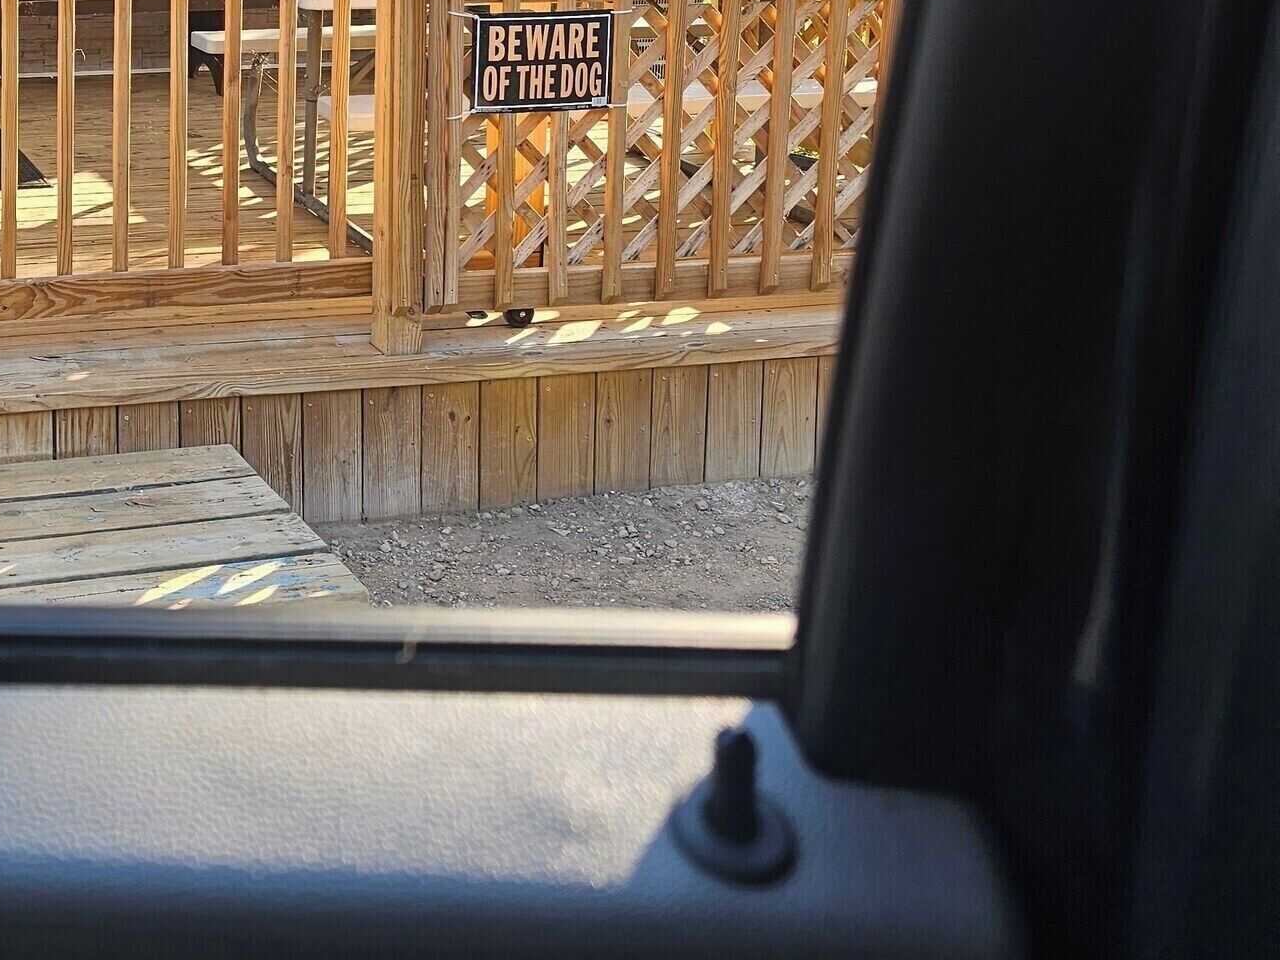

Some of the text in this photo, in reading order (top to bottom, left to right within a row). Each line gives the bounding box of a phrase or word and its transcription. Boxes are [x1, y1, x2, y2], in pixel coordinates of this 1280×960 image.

[488, 22, 600, 62] BEWARE
[482, 61, 603, 102] OF THE DOG
